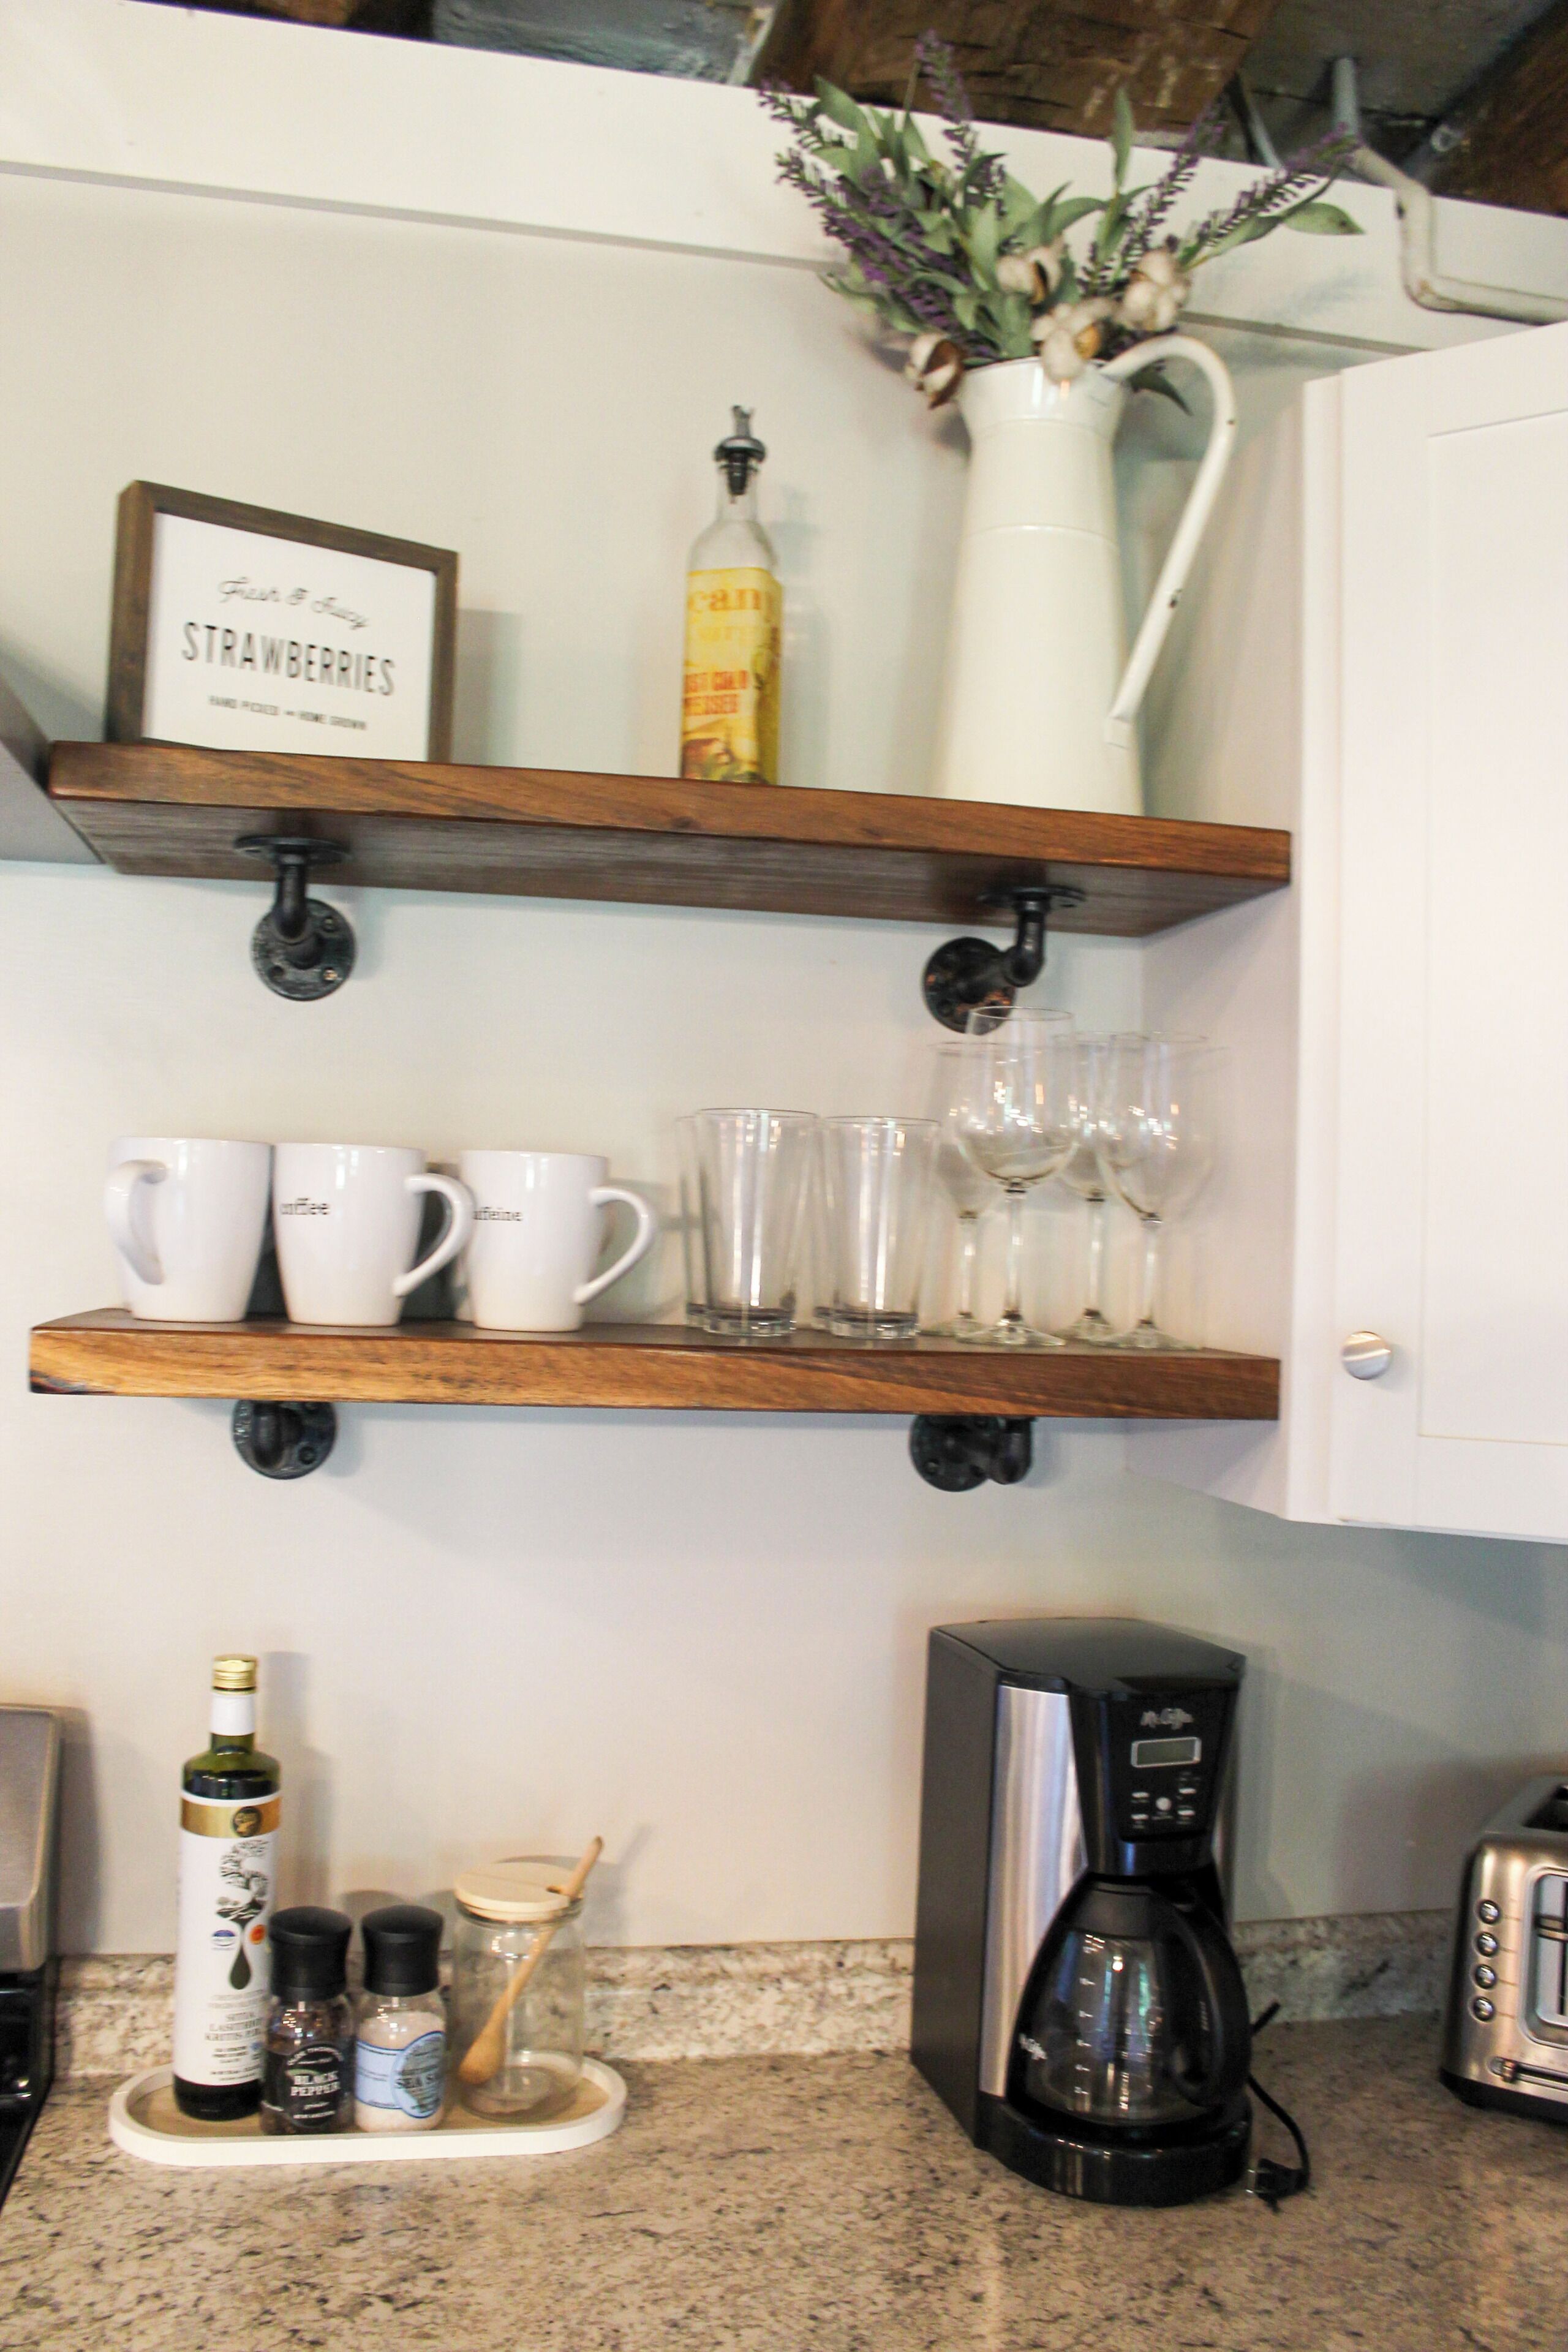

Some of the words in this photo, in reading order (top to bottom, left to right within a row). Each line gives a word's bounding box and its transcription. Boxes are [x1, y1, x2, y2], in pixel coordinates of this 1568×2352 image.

[181, 621, 396, 697] STRAWBERRIES
[298, 710, 326, 725] HOME
[330, 716, 368, 731] GROWN
[280, 1197, 331, 1215] coffee
[473, 1206, 522, 1221] affeine
[293, 2070, 339, 2086] BLACK
[290, 2081, 341, 2097] PEPPER
